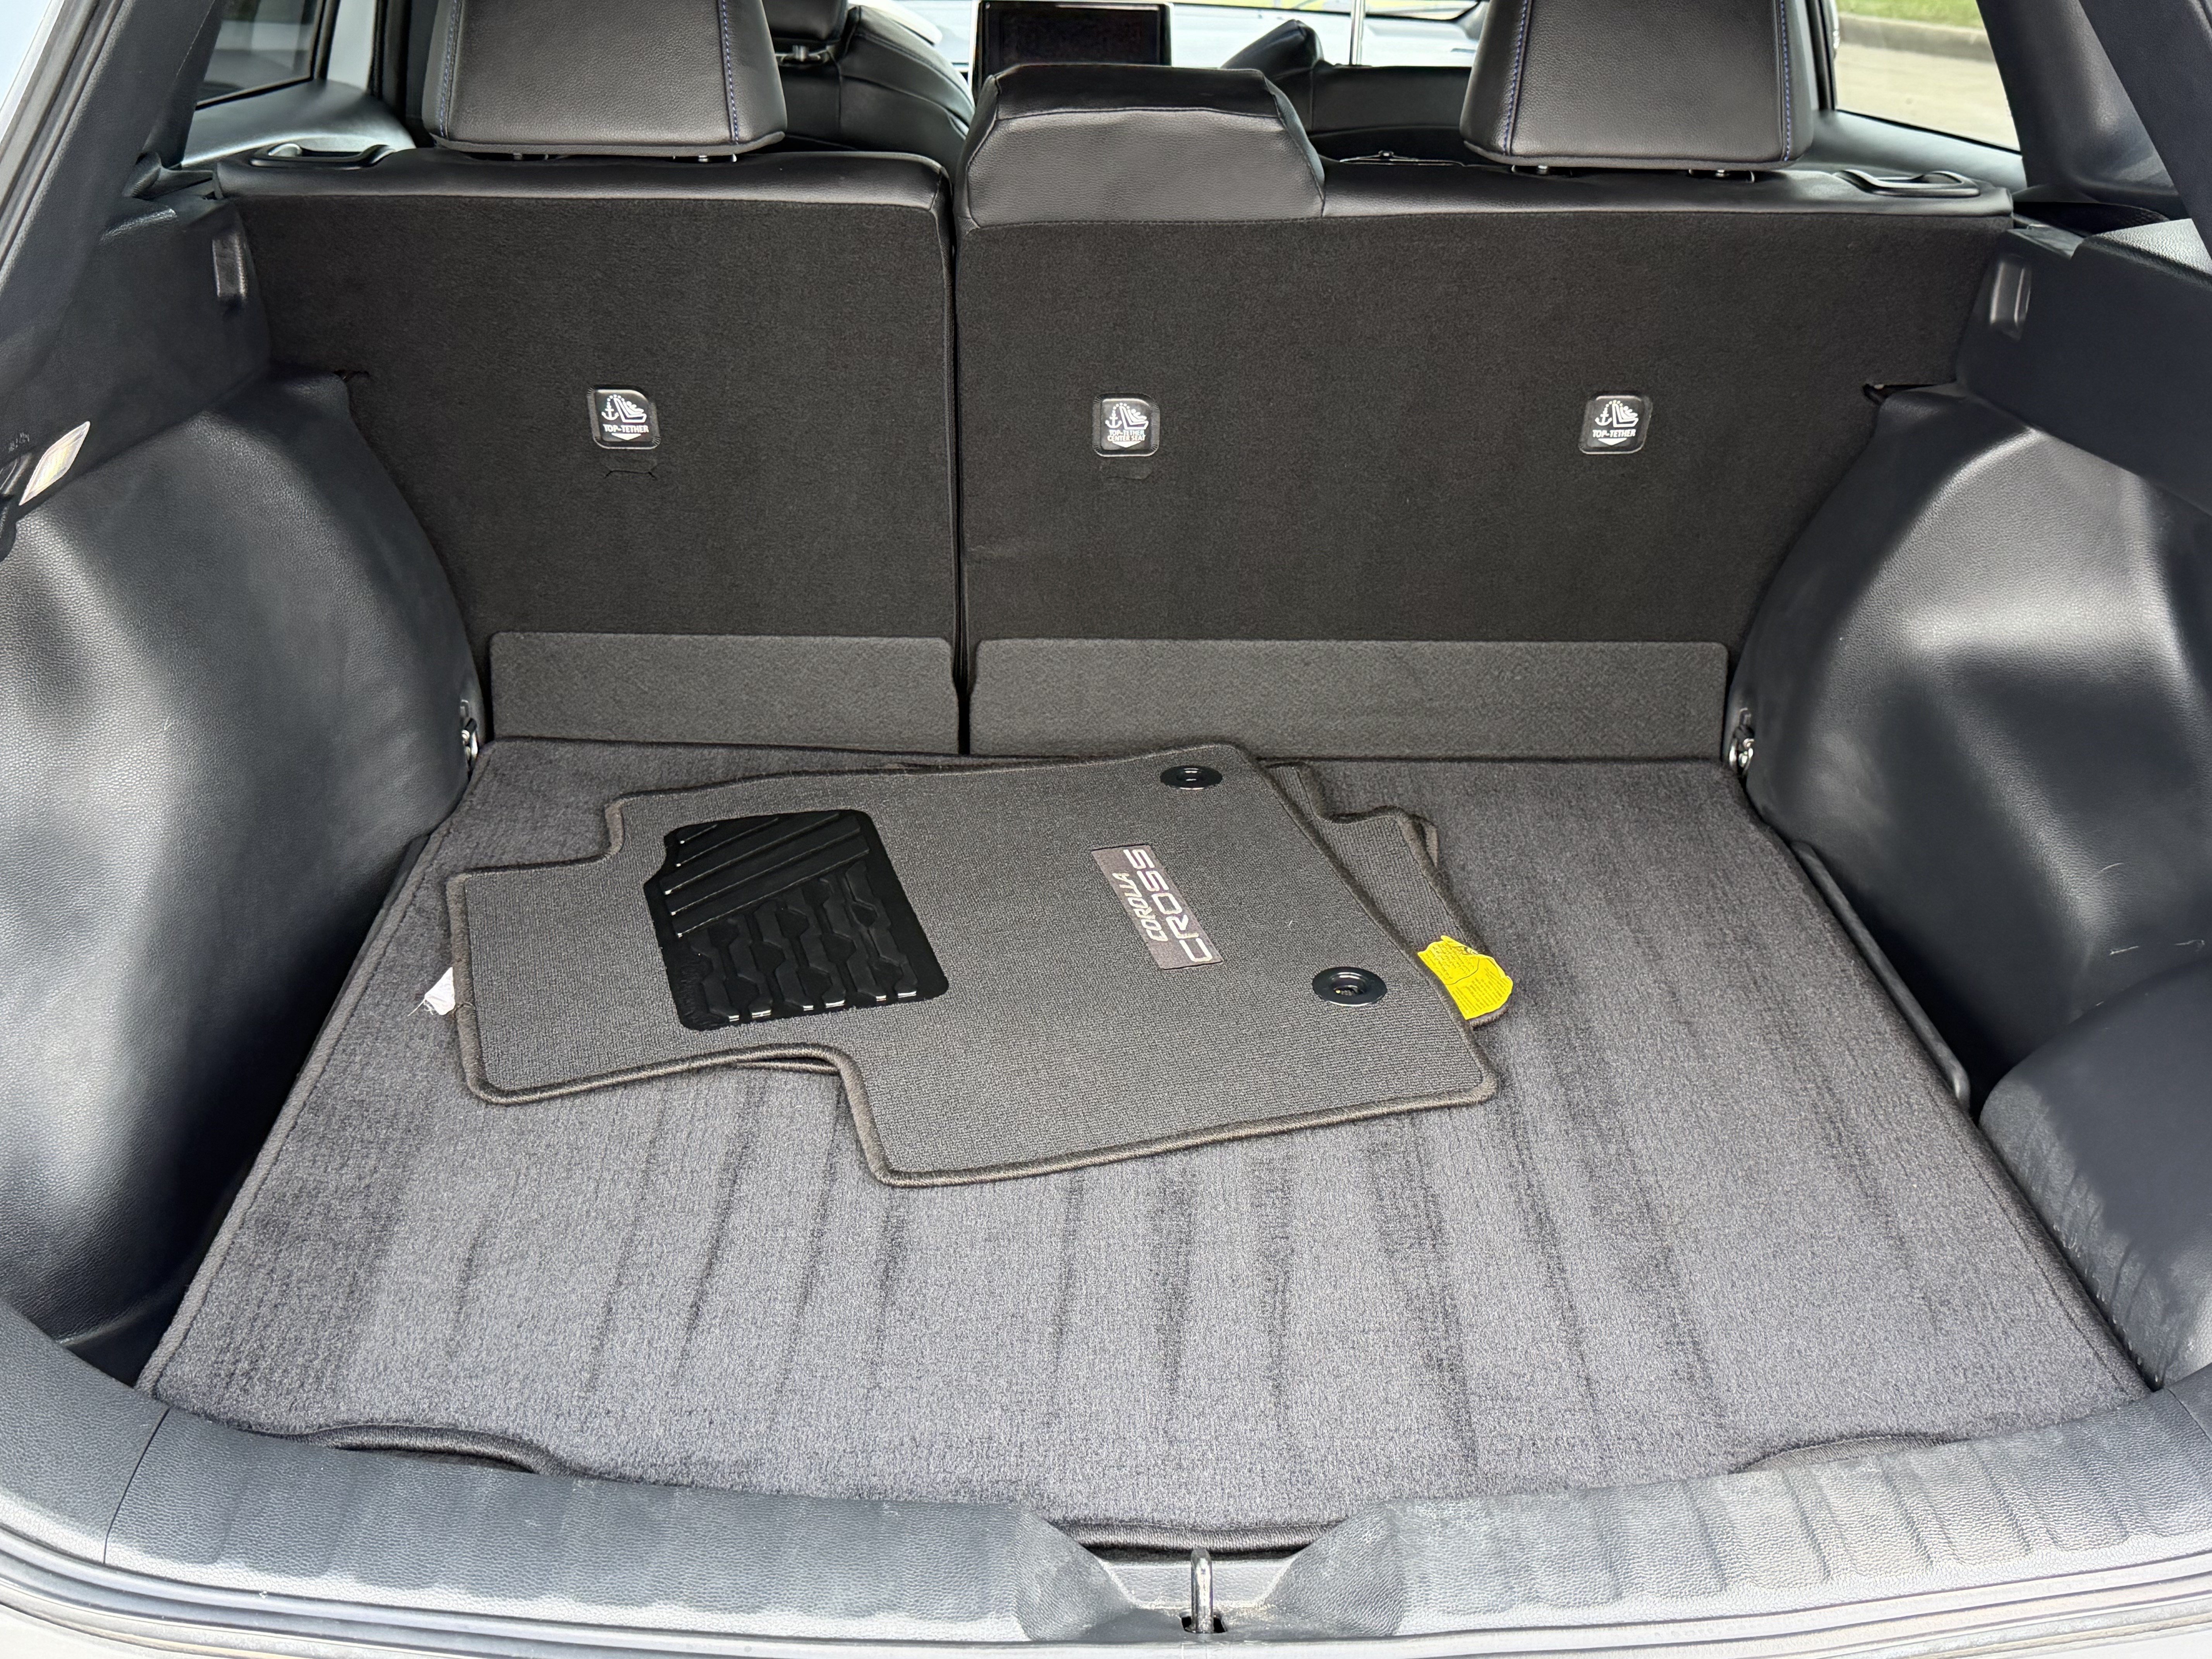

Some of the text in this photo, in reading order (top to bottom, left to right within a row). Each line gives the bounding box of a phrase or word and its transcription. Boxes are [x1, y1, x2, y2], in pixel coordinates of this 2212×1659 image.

[603, 424, 649, 433] TOP-TETHER
[1592, 429, 1636, 438] TOP-TETHER
[1112, 873, 1168, 941] COROLLA
[1123, 849, 1213, 962] CROSS
